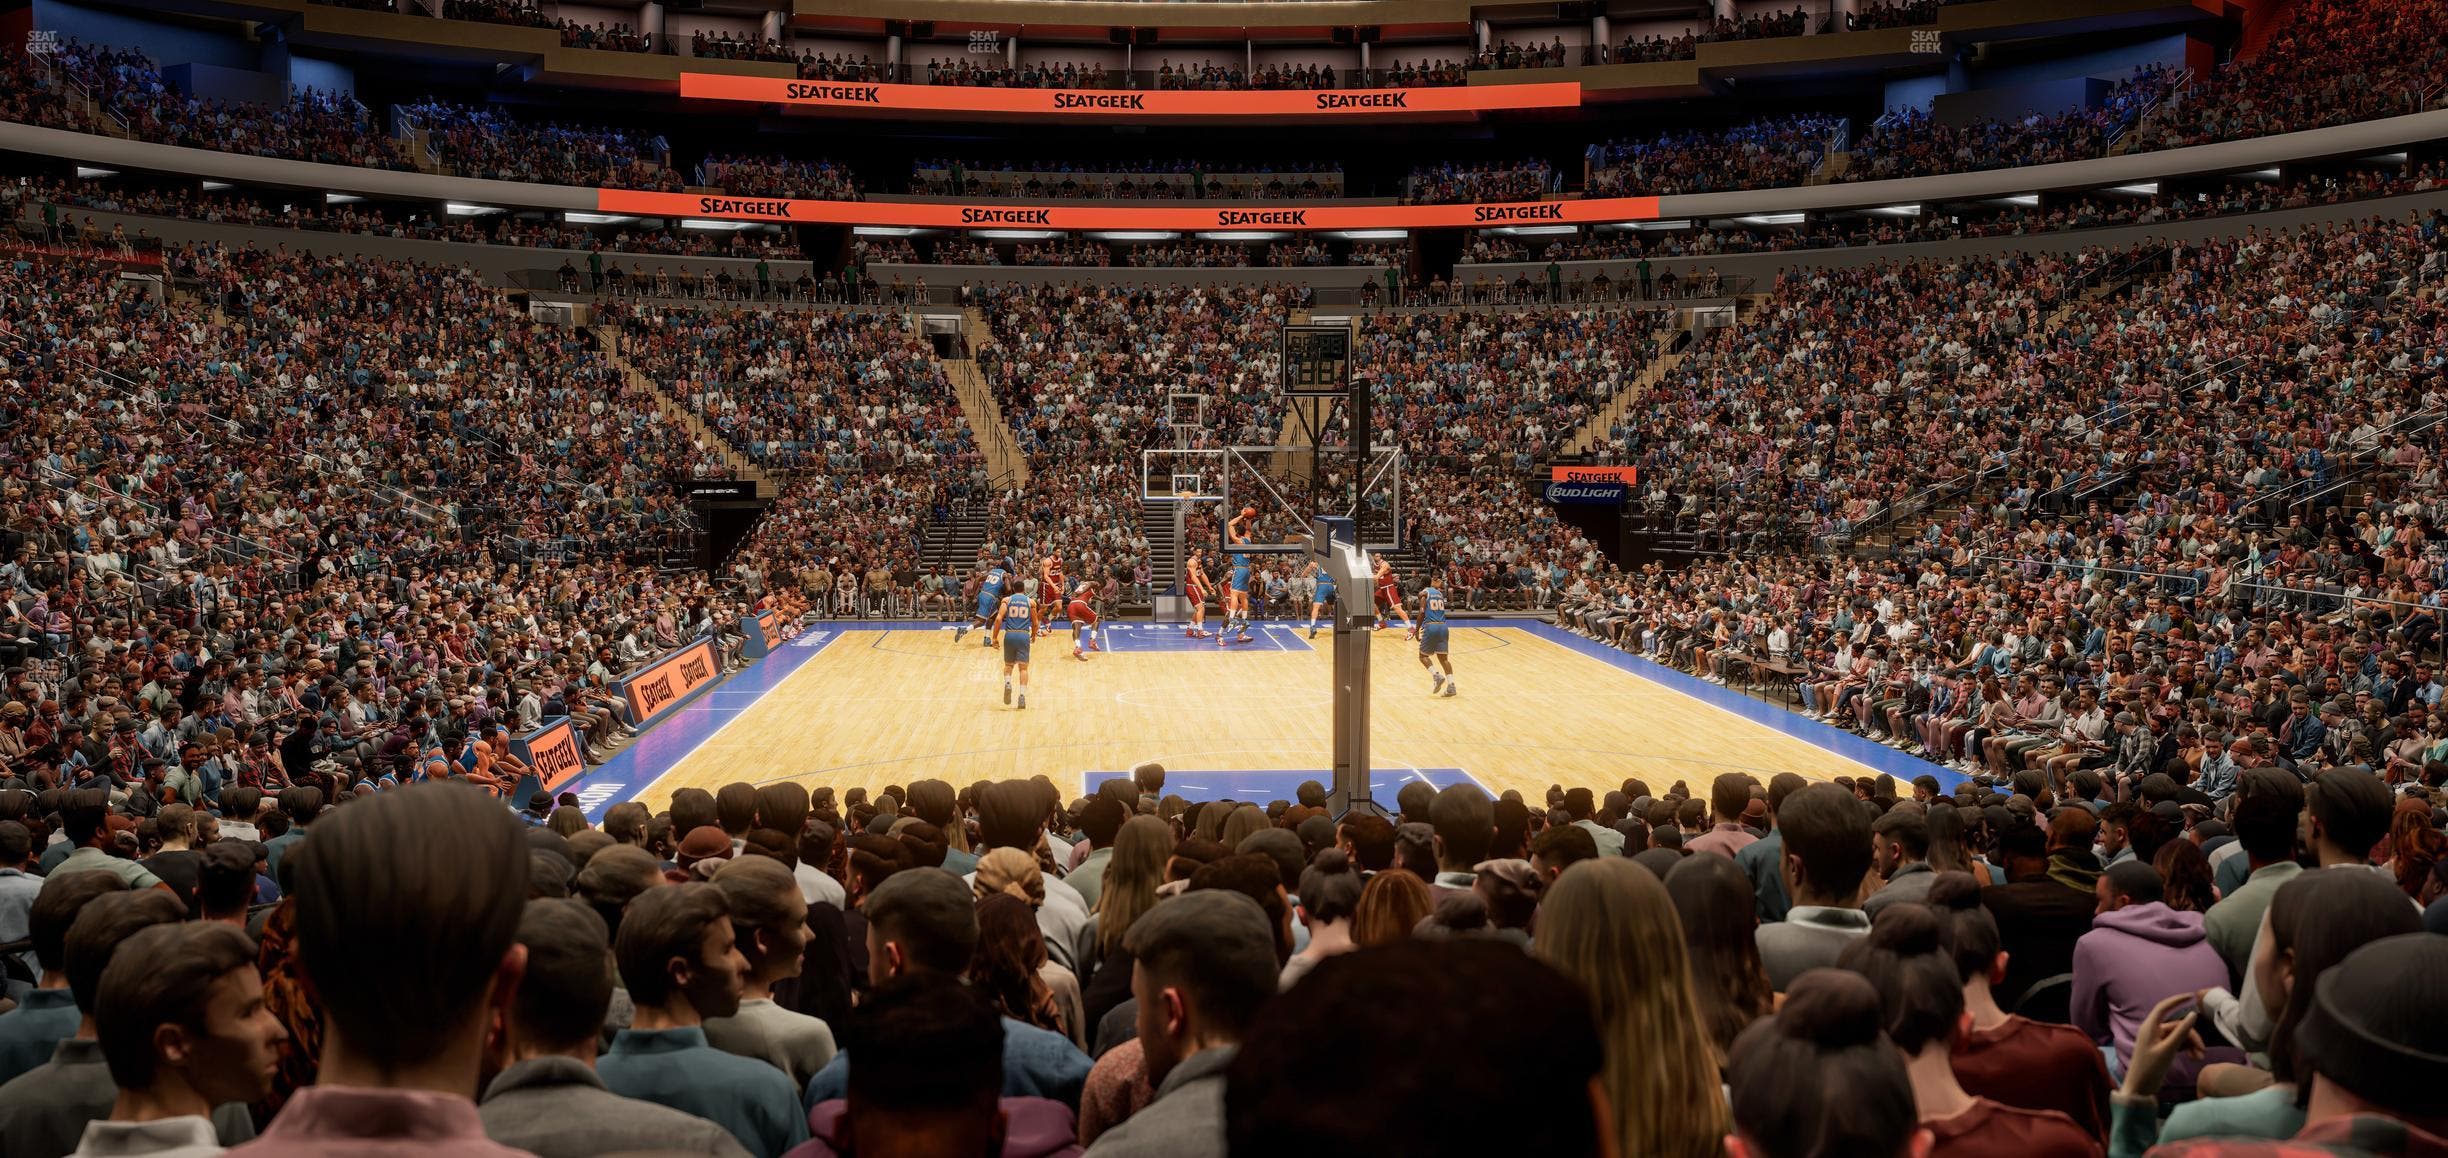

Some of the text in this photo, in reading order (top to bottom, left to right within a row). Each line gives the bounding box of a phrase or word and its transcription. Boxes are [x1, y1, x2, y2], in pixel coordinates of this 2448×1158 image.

[788, 84, 879, 103] SEATGEEK
[1055, 93, 1144, 109] SEATGEEK
[1317, 92, 1406, 109] SEATGEEK
[701, 198, 790, 217] SEATGEEK
[1475, 204, 1562, 221] SEATGEEK
[962, 209, 1049, 224] SEATGEEK
[1219, 211, 1305, 225] SEATGEEK
[1552, 488, 1620, 498] BUD LIGHT
[1009, 606, 1029, 618] 00
[1430, 599, 1445, 611] 00
[680, 653, 709, 689] SEATGEEK
[640, 672, 675, 712] SEATGEEK
[535, 734, 578, 785] SEATGEEK
